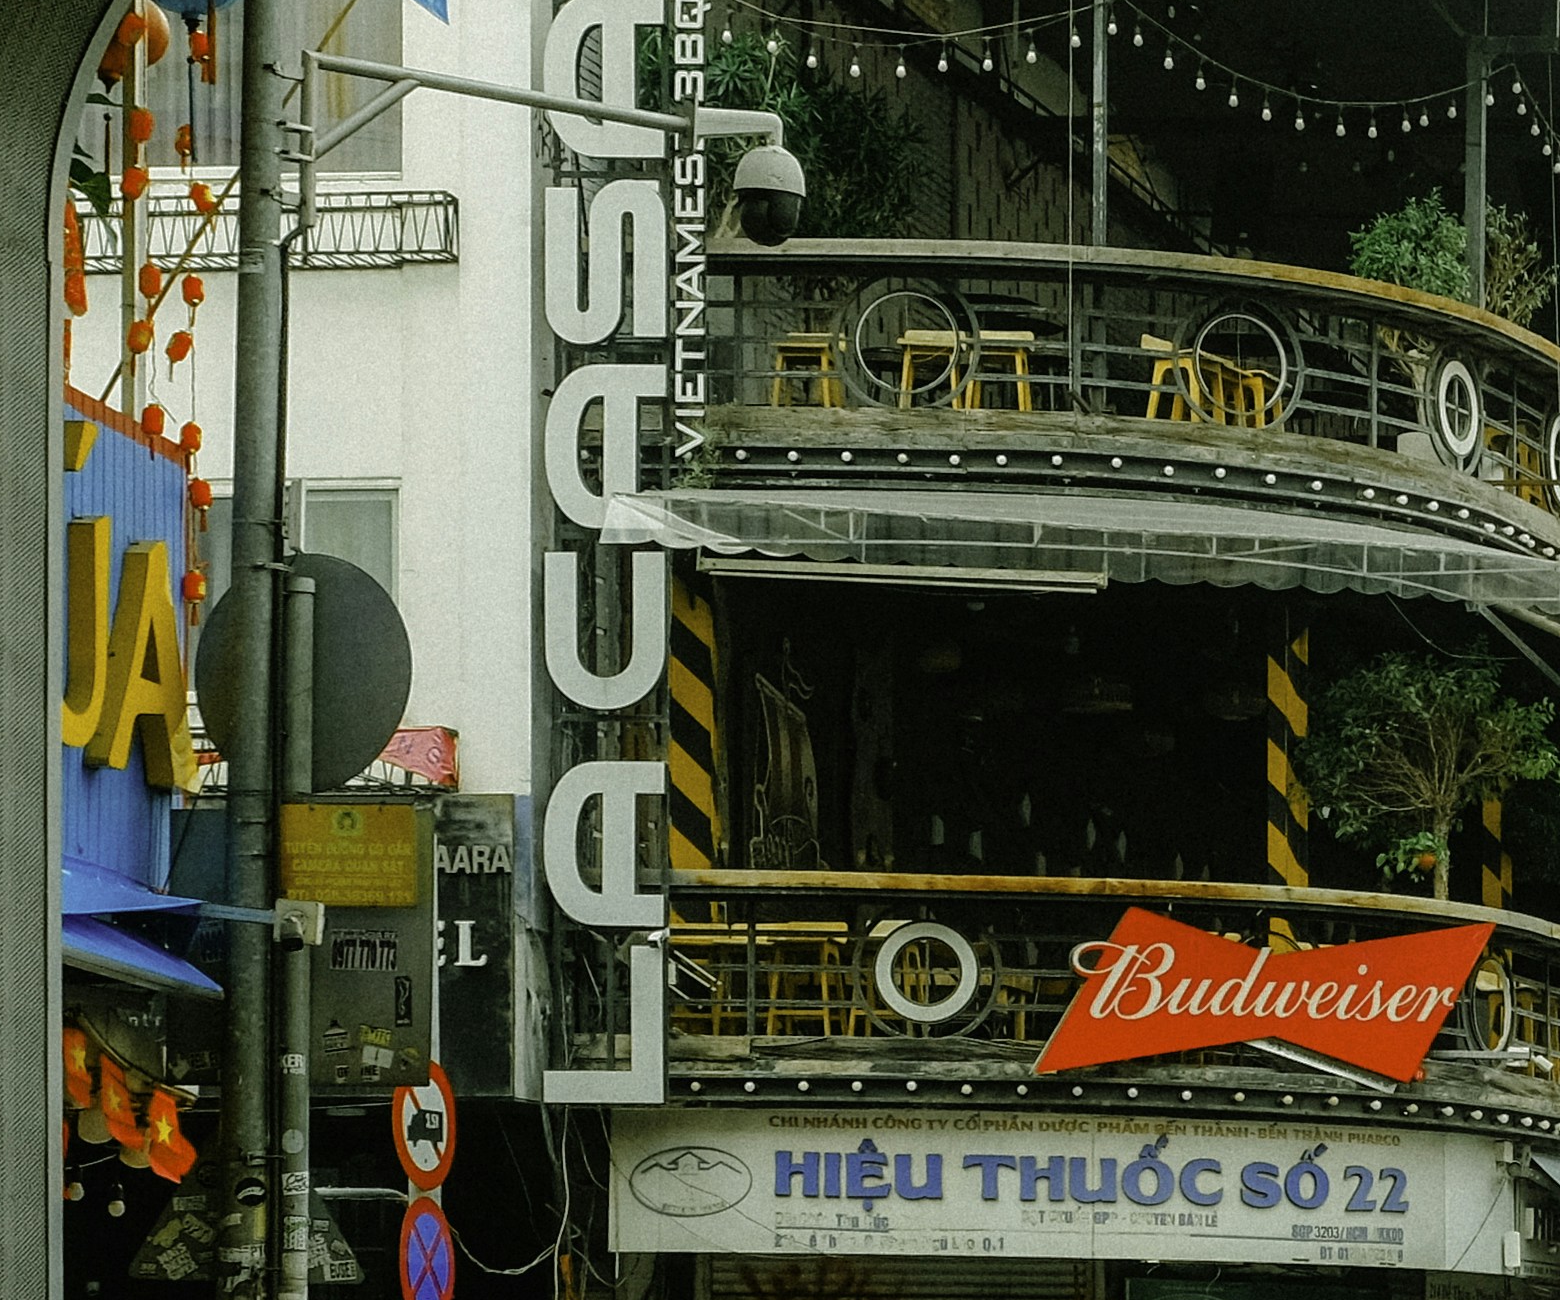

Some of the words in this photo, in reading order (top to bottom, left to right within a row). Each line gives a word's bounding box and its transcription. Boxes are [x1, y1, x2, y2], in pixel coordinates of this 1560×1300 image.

[1070, 940, 1458, 1025] Budweiser
[768, 1114, 800, 1129] CHI
[802, 1113, 868, 1131] NHÁNH
[871, 1113, 923, 1131] CÔNG
[925, 1117, 948, 1132] TY
[1347, 1131, 1402, 1148] PHARCO
[773, 1138, 943, 1213] HIỆU
[962, 1133, 1224, 1208] THUỐC
[1240, 1142, 1331, 1211] SỐ
[1343, 1165, 1411, 1214] 22
